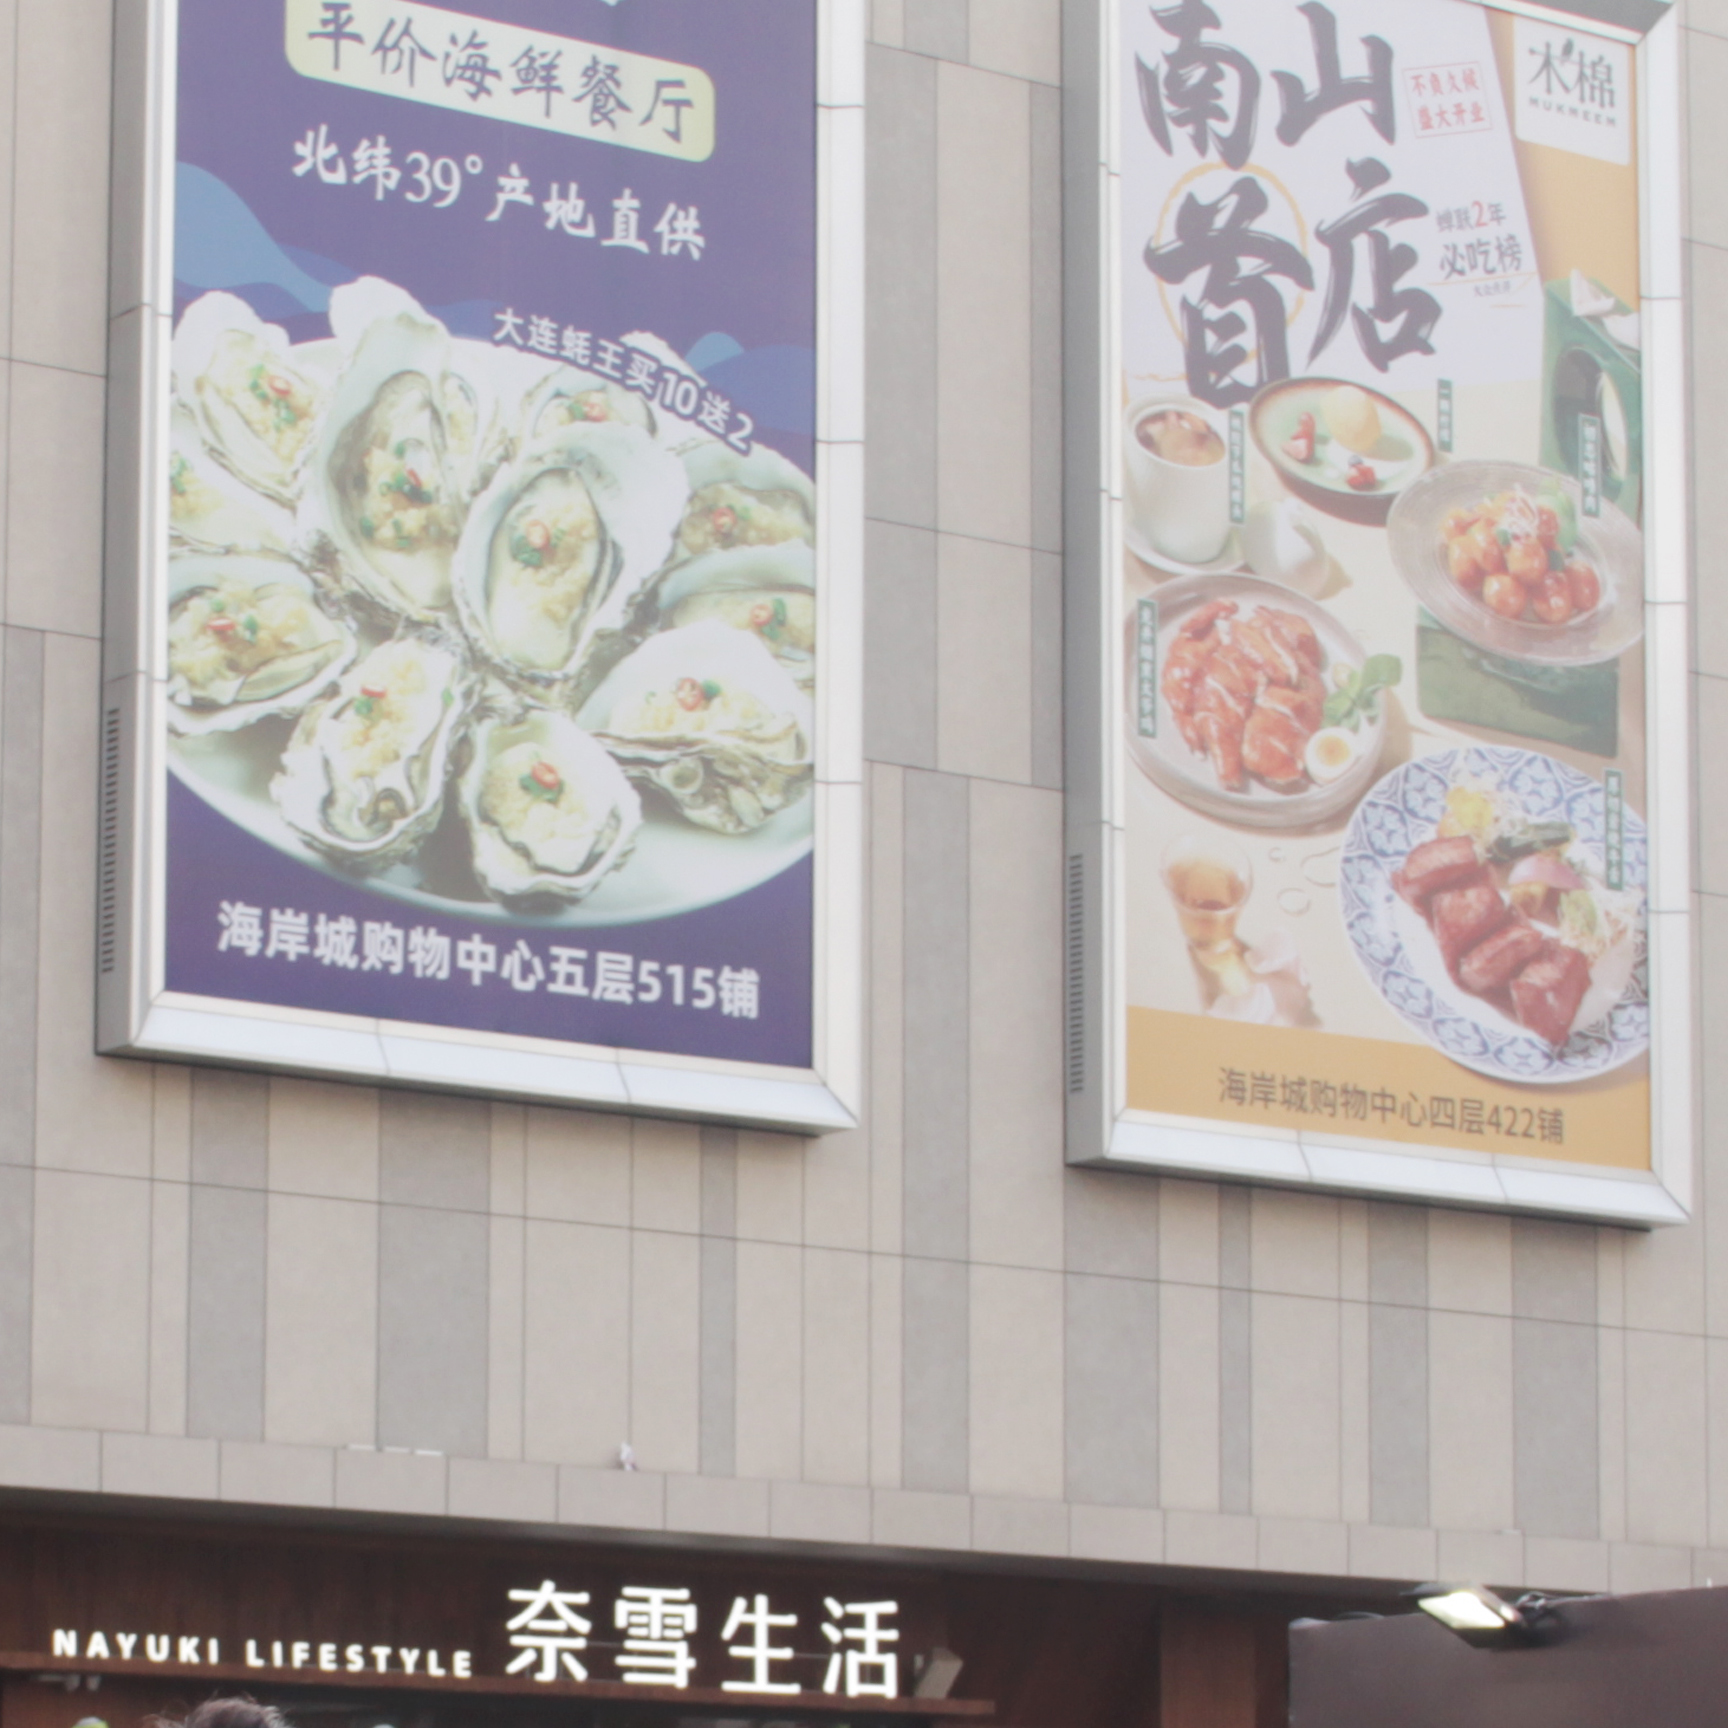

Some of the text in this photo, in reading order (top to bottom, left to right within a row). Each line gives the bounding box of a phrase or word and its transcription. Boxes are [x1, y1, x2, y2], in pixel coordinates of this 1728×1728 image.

[307, 1, 696, 145] 平价海鲜餐厅
[1135, 0, 1395, 170] 南山
[1529, 40, 1615, 108] 木棉
[292, 124, 706, 260] 北纬39°产地直供
[1439, 233, 1522, 280] 必吃榜
[493, 306, 754, 452] 大连蚝王买10送2
[217, 900, 760, 1019] 海岸城购物中心五层515铺
[1218, 1066, 1564, 1144] 海岸城购物中心四层422铺
[52, 1628, 472, 1680] NAYUKI LIFESTYLE
[505, 1579, 899, 1699] 奈雪生活
